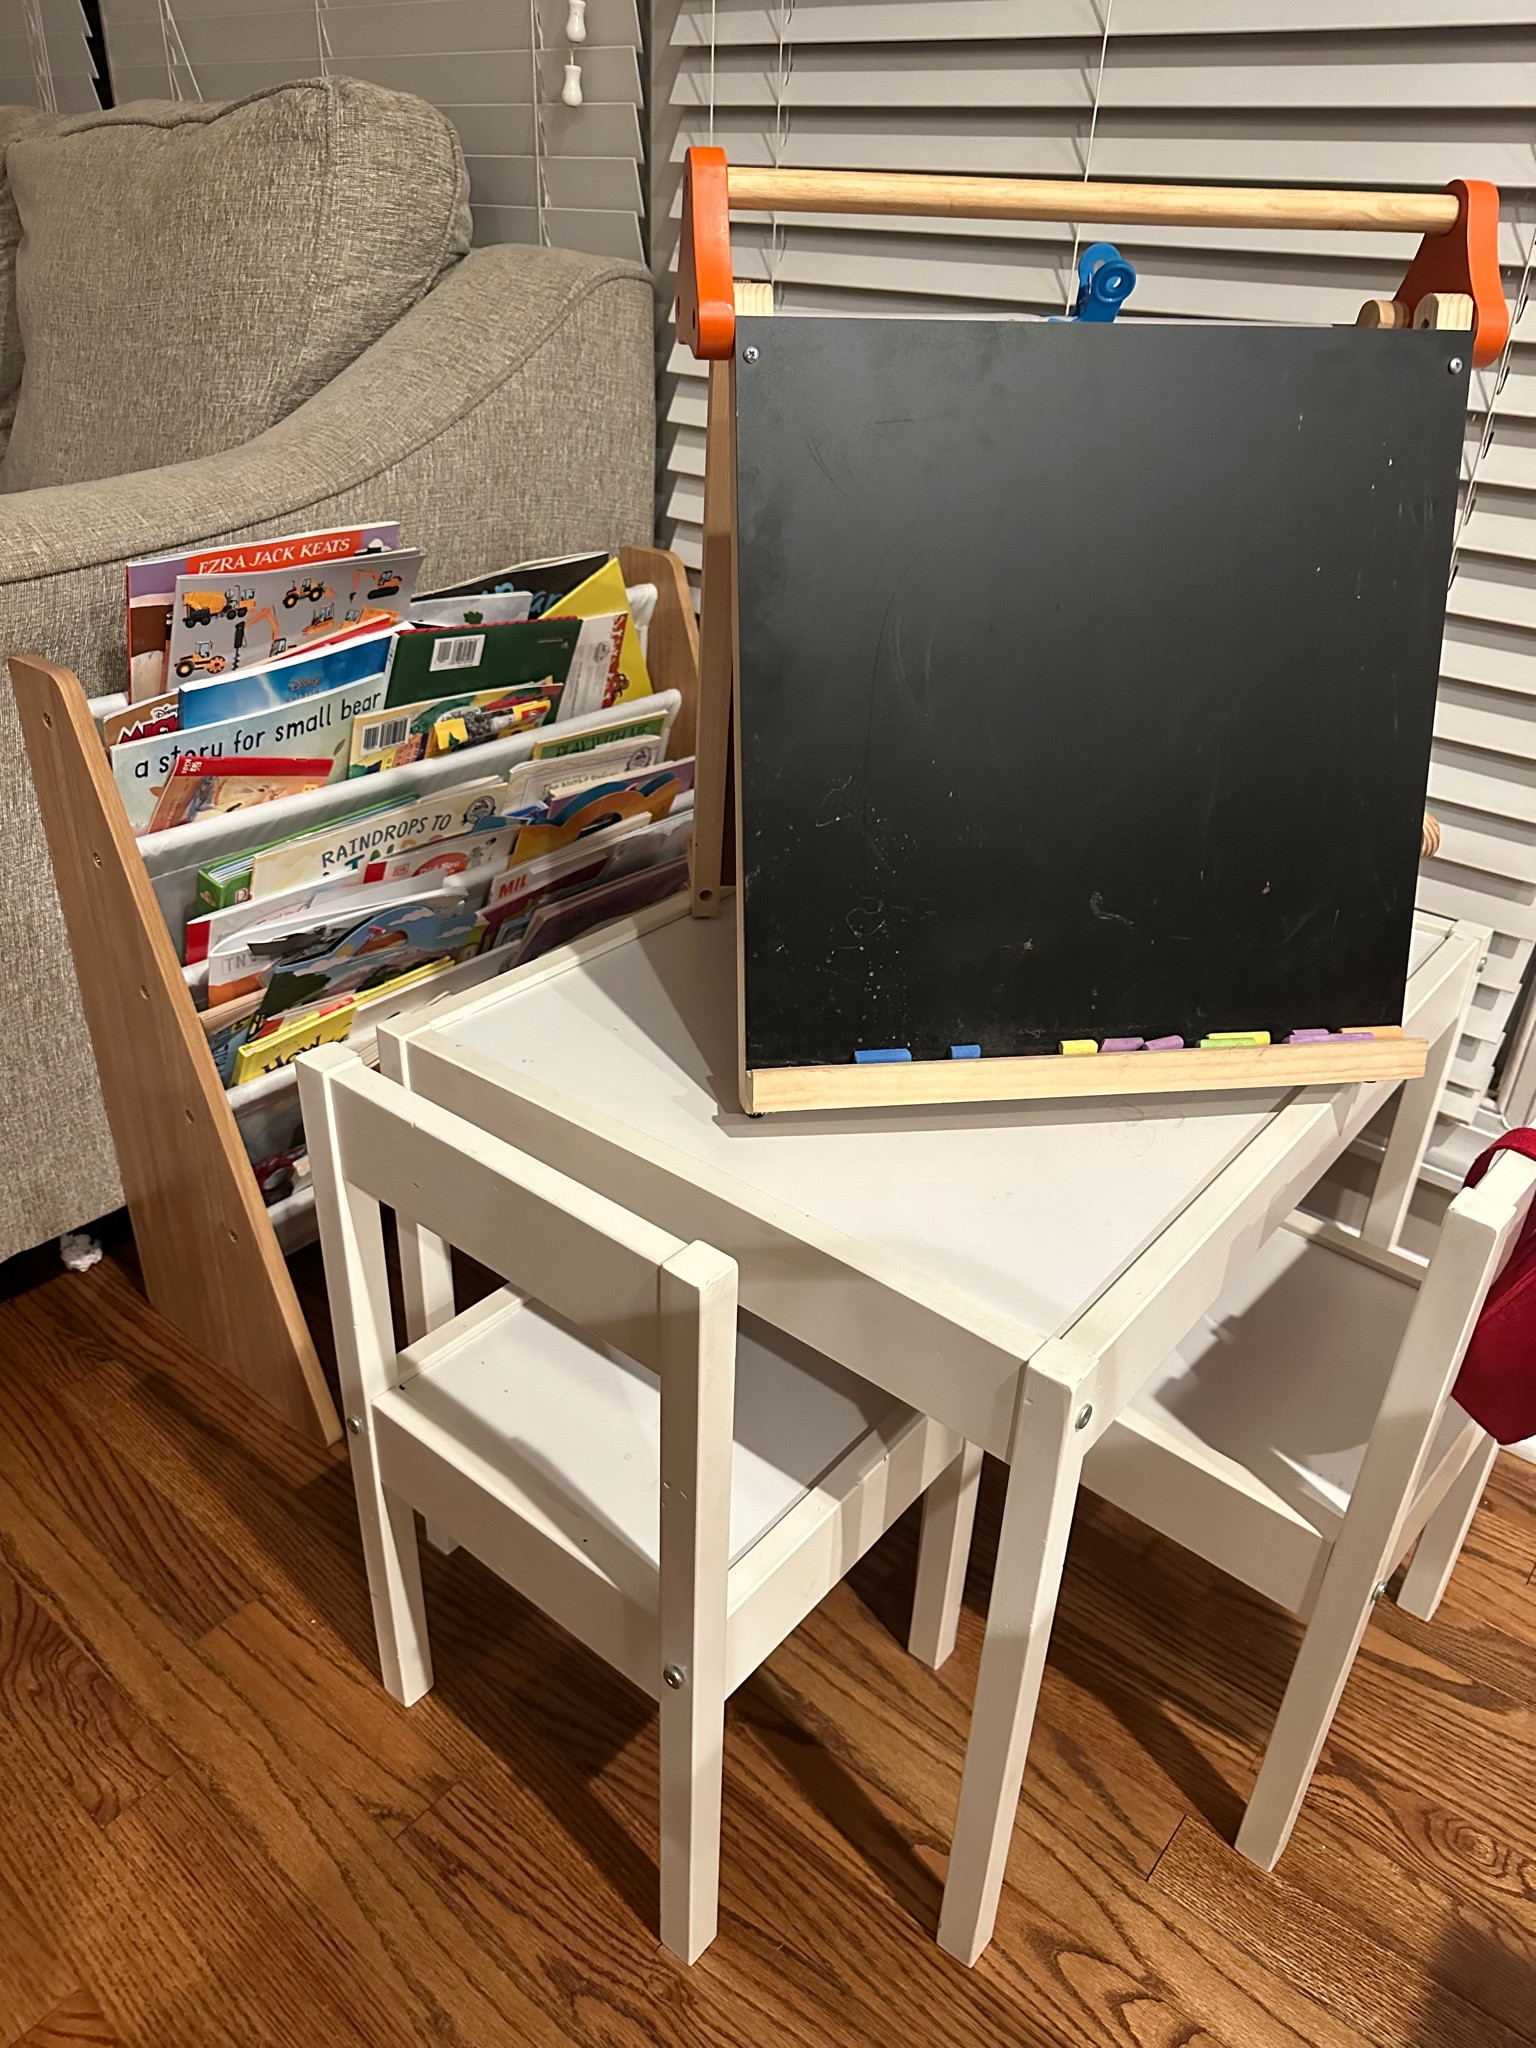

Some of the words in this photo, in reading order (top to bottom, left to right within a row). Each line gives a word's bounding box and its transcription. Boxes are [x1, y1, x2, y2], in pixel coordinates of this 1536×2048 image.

[198, 554, 246, 575] EZRA
[249, 546, 296, 566] JACK
[300, 538, 350, 558] KEATS
[135, 760, 148, 778] a
[234, 730, 265, 753] for
[275, 704, 331, 742] small
[341, 692, 381, 720] bear
[321, 816, 428, 868] RAINDROPS
[432, 814, 452, 831] TO
